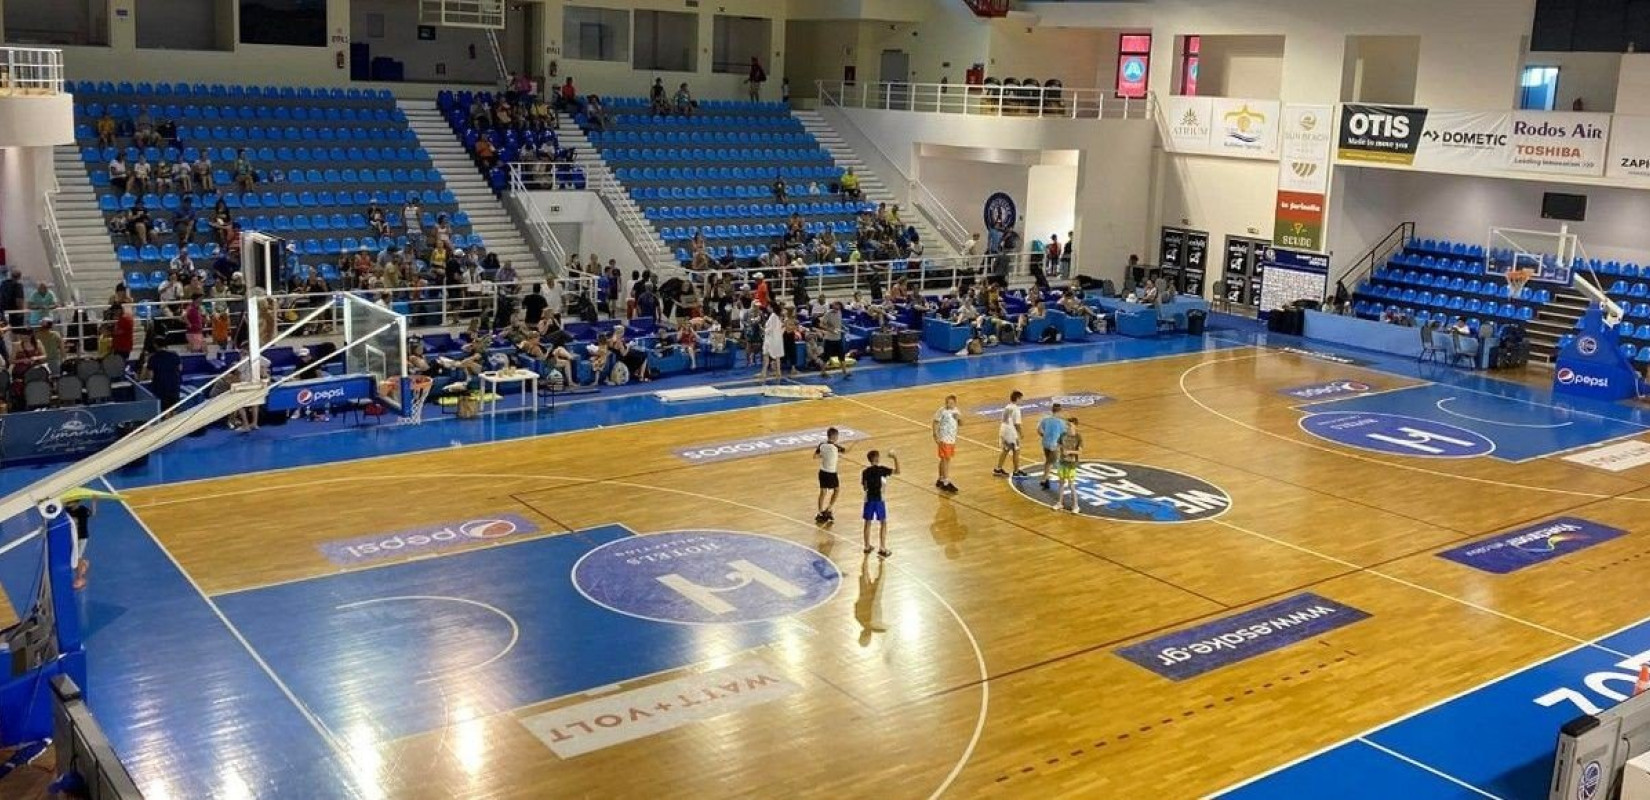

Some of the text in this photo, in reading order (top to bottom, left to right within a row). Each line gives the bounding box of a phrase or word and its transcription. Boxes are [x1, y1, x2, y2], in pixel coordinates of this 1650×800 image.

[1349, 113, 1410, 138] OTIS
[1514, 120, 1603, 139] Rodos Air
[1442, 131, 1508, 146] DOMETIC
[1516, 145, 1582, 157] TOSHIBA
[1574, 374, 1609, 387] pepsi
[313, 387, 345, 402] pepsi
[1151, 490, 1229, 514] WE
[347, 528, 457, 558] pepsi
[1156, 605, 1337, 666] www.esake.gr
[550, 673, 780, 743] WATT+VOLT
